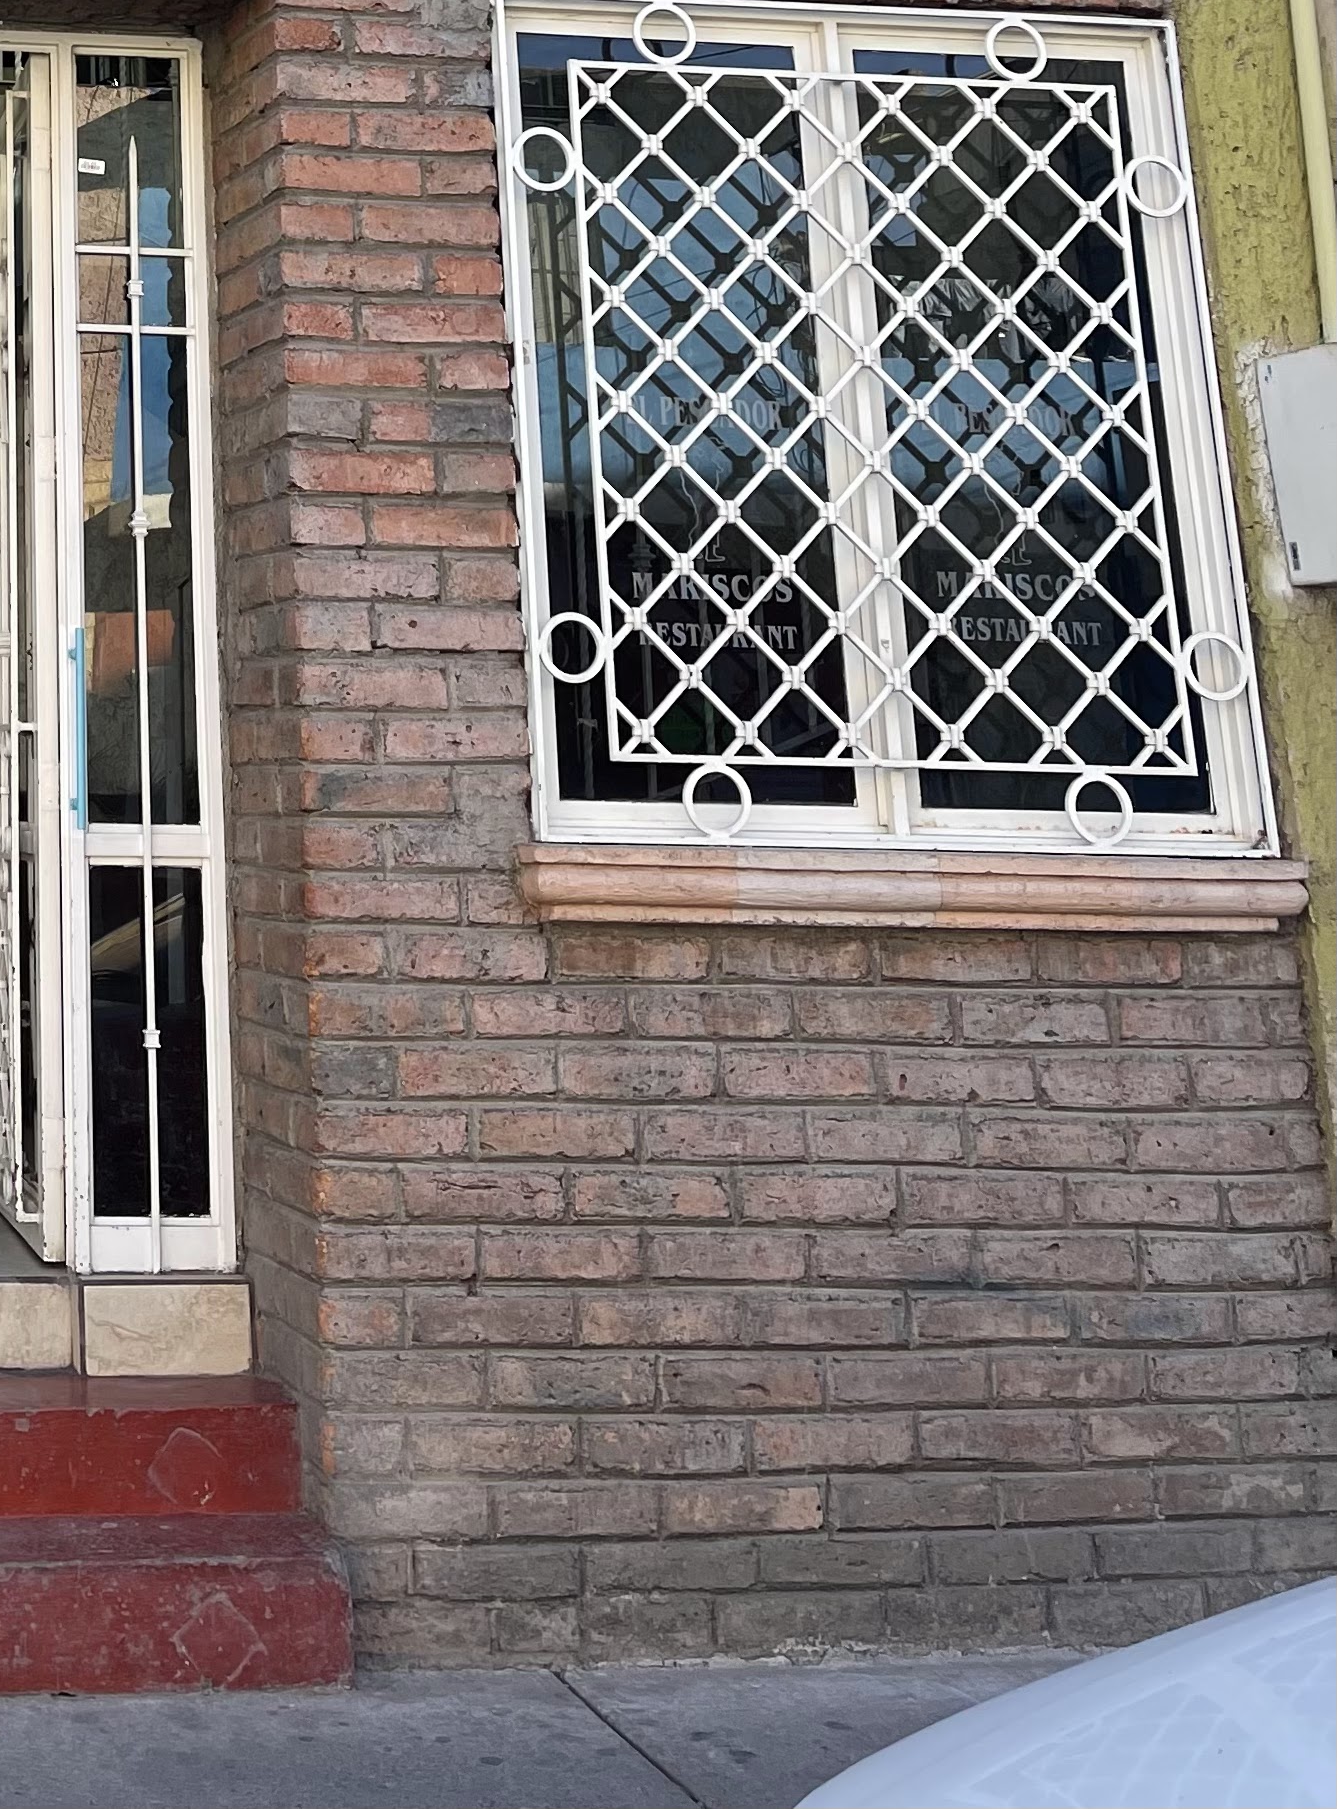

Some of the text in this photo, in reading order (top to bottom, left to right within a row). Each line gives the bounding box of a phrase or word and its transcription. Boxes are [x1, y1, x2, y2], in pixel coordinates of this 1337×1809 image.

[659, 395, 784, 431] PESDOR
[953, 402, 1075, 437] PESDOR
[947, 616, 1102, 646] ESTAANT
